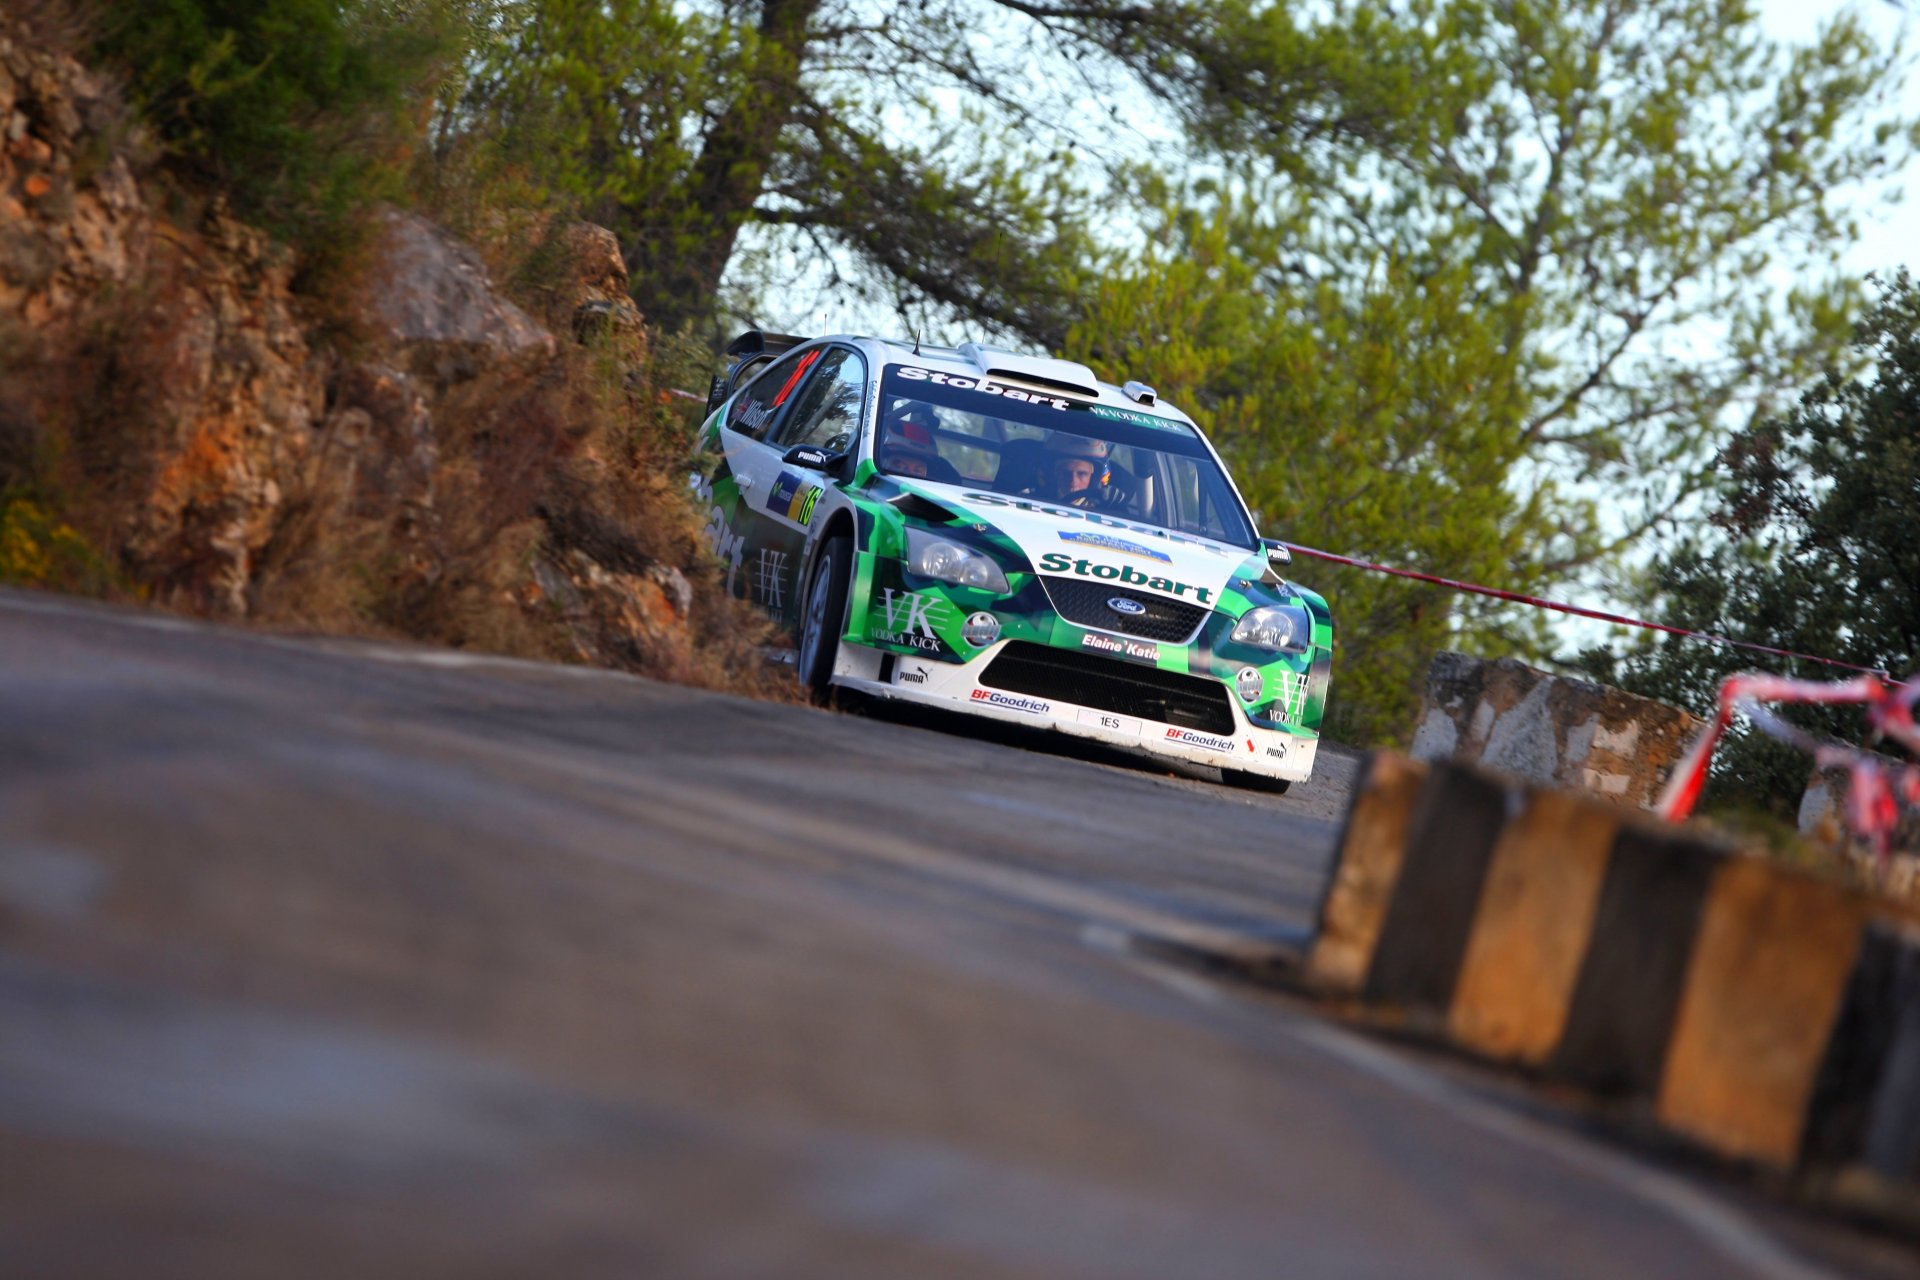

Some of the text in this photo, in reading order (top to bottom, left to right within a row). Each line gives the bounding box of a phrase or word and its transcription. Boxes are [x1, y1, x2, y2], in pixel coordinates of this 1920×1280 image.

[896, 366, 1070, 412] Stobart
[1089, 406, 1108, 417] VK
[1109, 409, 1150, 424] VODKA
[799, 485, 822, 526] 16
[760, 548, 787, 607] VK
[1038, 552, 1214, 605] Stobart
[882, 587, 943, 640] VK
[871, 627, 941, 652] VODKA KICK
[1081, 633, 1122, 653] Elaine
[899, 671, 924, 684] PUMA
[971, 688, 1050, 713] BFGoodrich
[1100, 715, 1120, 729] 1ES
[1165, 727, 1236, 751] BFGoodrich
[1266, 746, 1284, 759] PUMA
